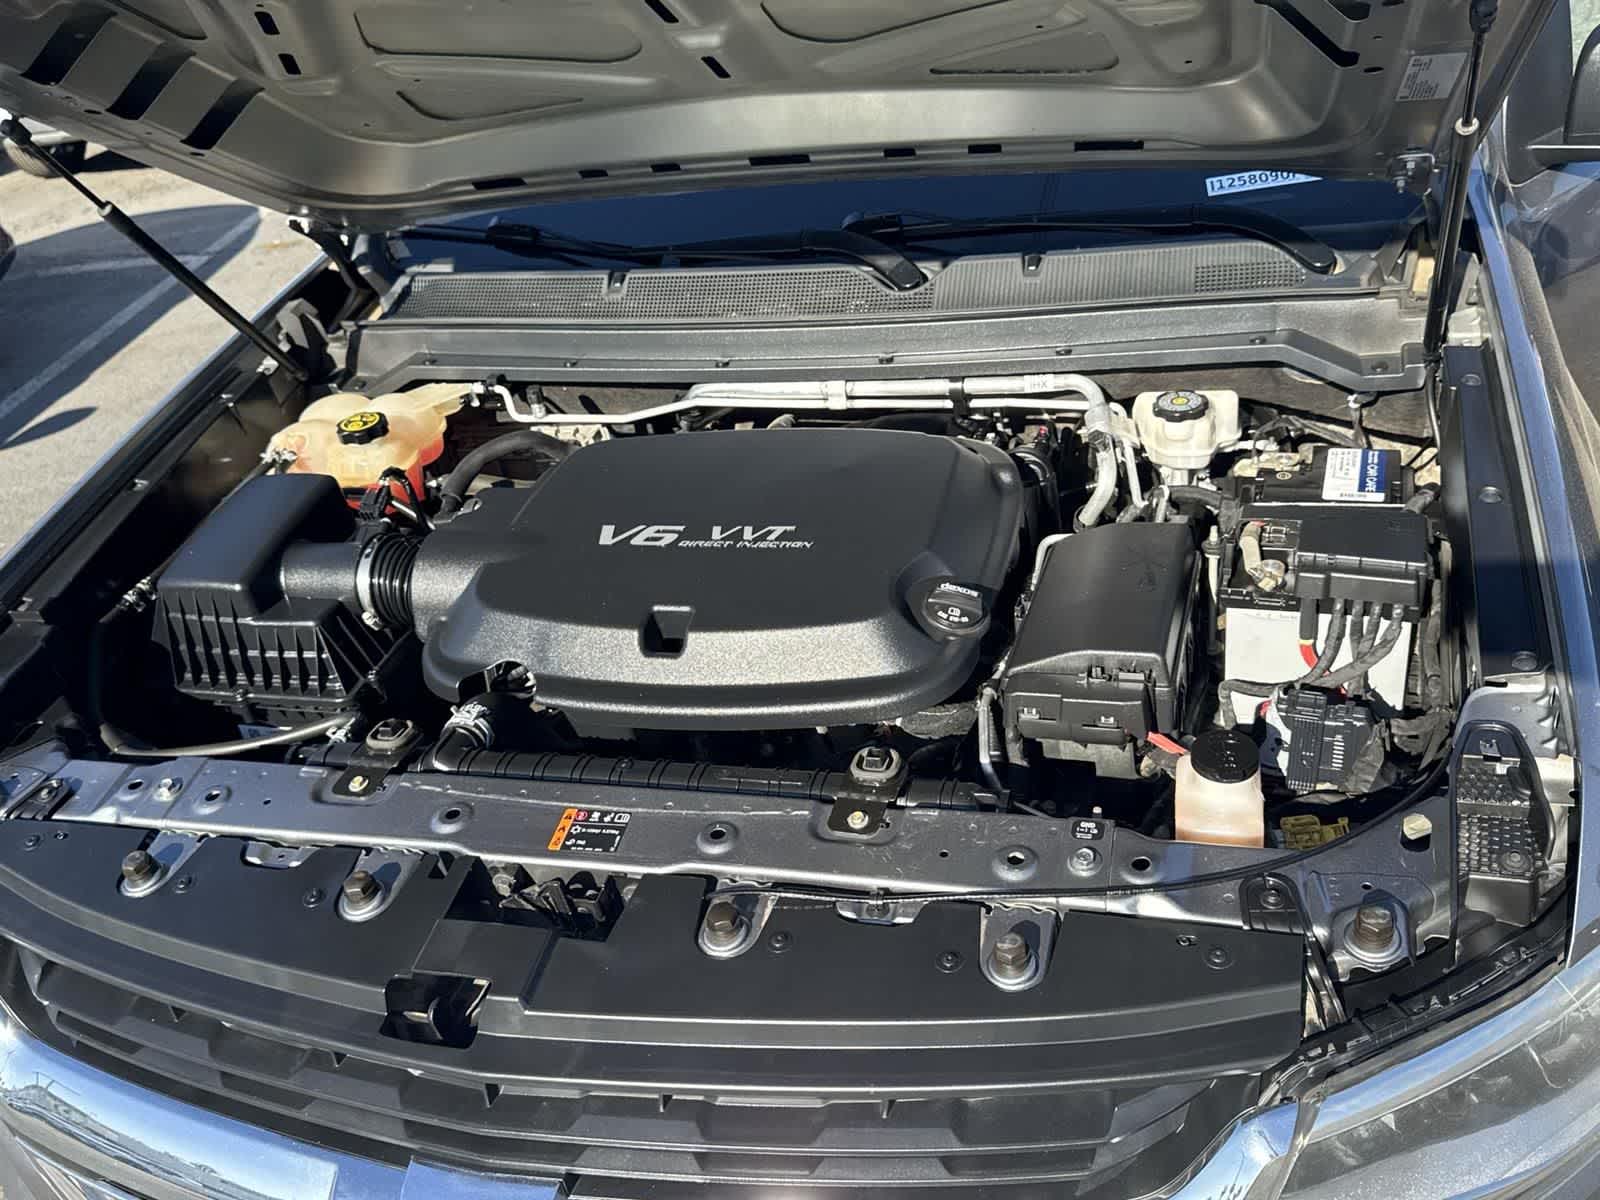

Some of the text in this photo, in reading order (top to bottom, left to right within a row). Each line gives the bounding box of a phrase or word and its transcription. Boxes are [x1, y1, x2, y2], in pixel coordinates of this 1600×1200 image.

[598, 524, 796, 547] V6 VVT
[677, 540, 814, 549] DIRECT INJECTION
